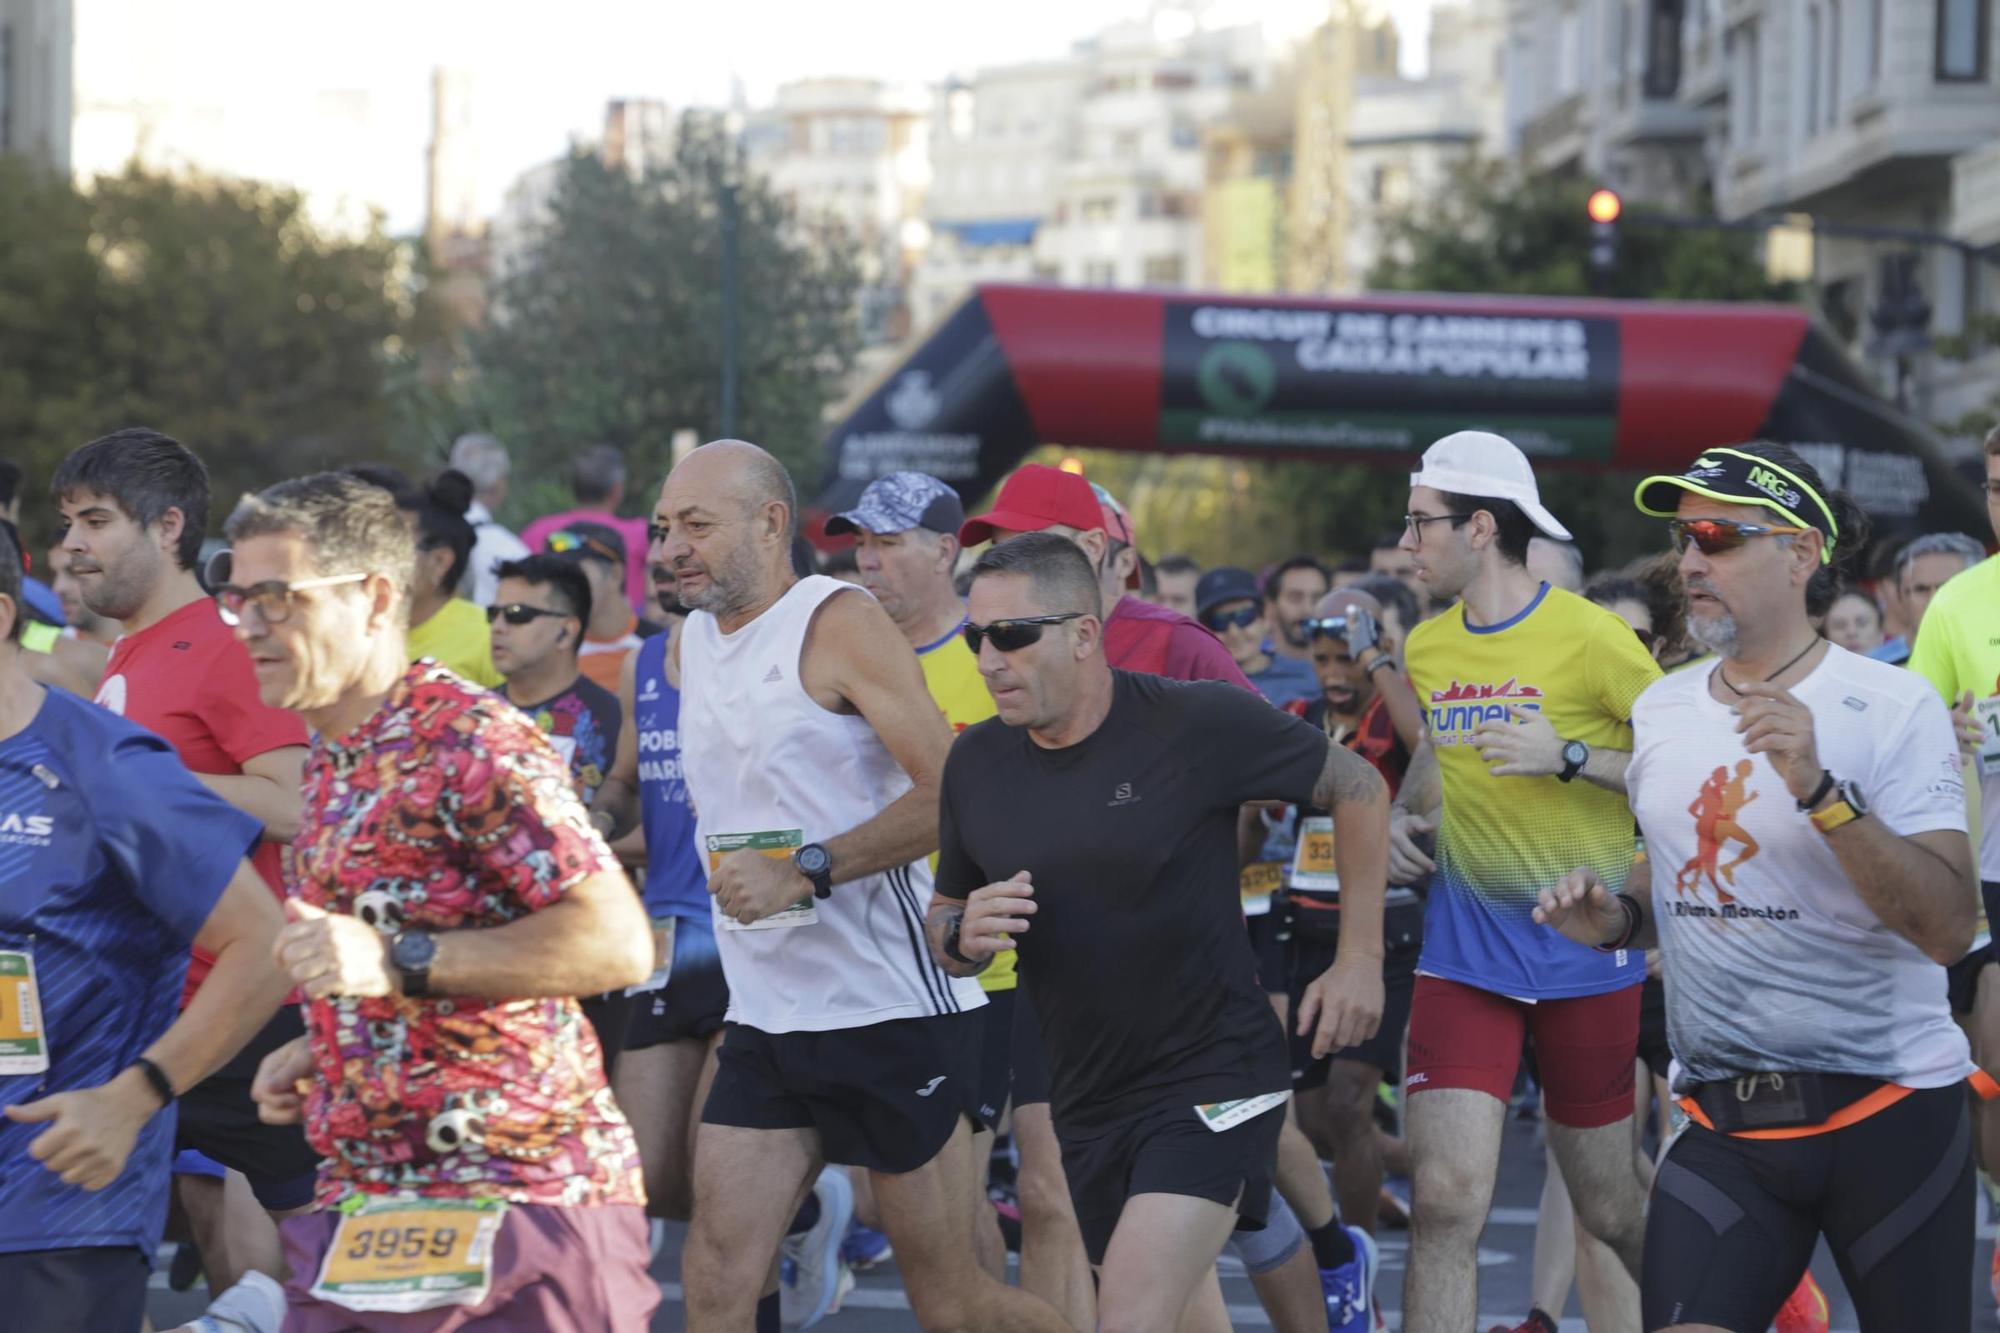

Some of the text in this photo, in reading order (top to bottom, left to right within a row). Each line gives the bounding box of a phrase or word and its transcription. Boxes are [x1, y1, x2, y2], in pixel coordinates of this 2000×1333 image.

[1191, 307, 1586, 346] CIRCUIT DE CARRERES
[0, 813, 54, 836] AS
[348, 1226, 458, 1260] 3959
